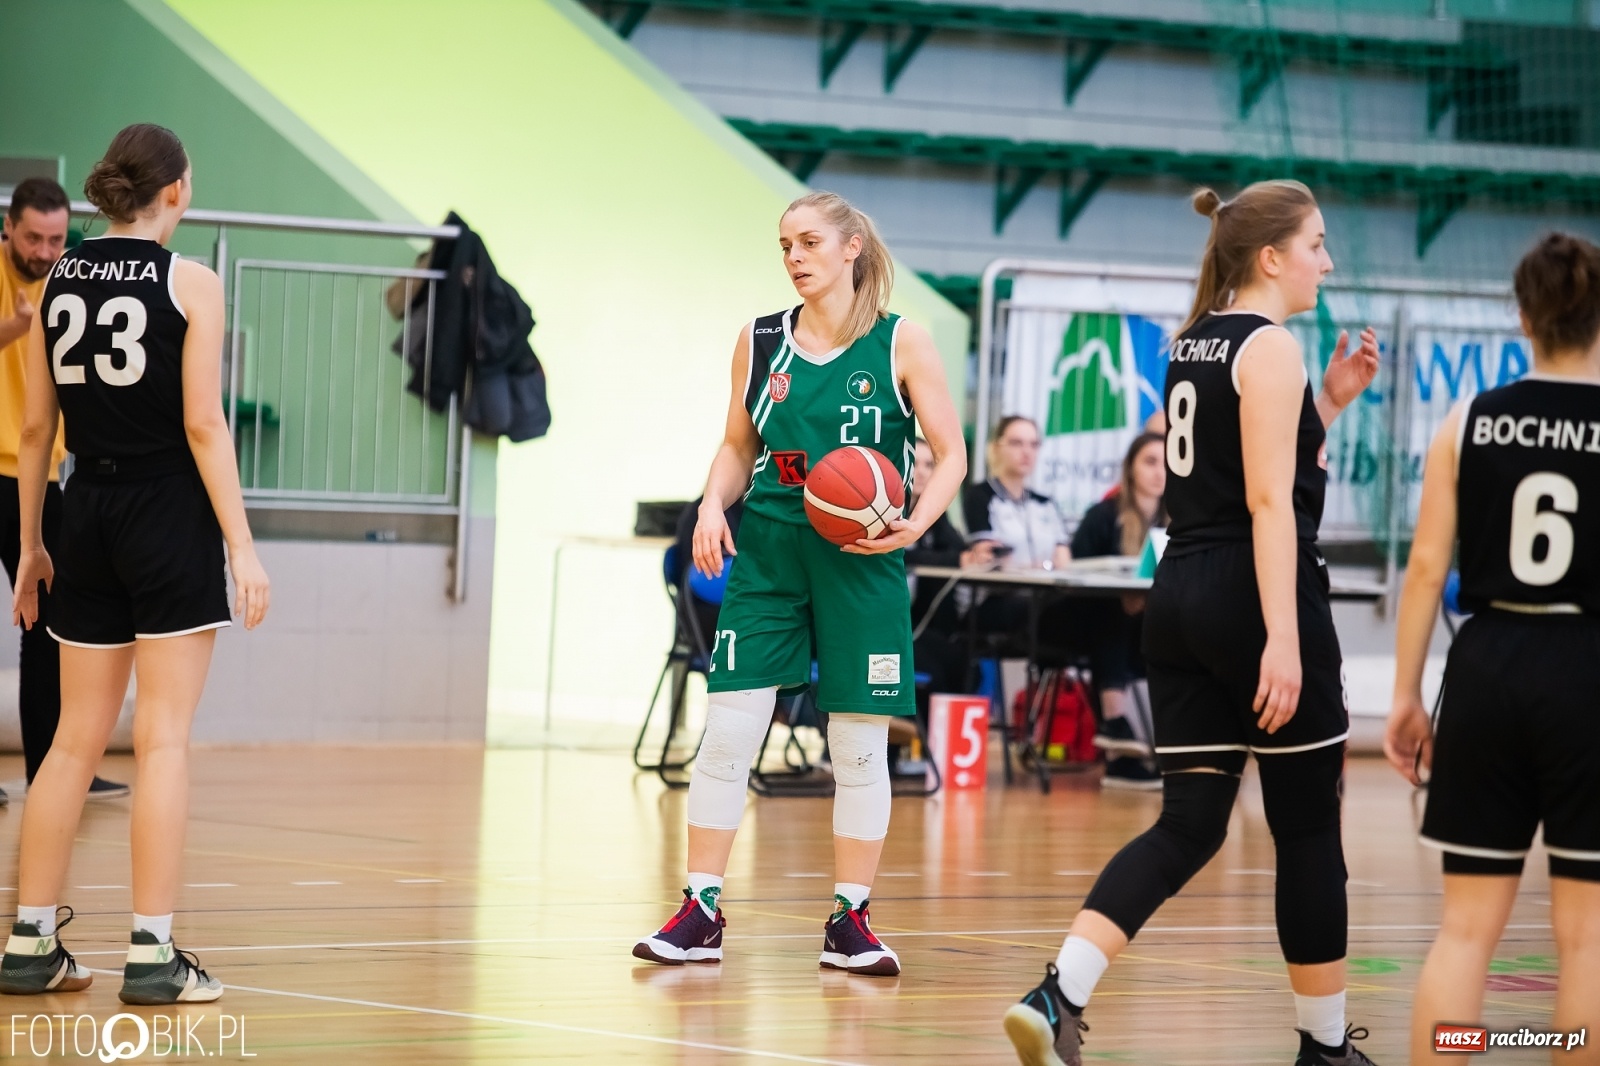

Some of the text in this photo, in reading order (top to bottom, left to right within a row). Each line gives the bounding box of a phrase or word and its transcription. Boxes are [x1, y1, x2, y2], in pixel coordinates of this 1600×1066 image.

[54, 257, 159, 283] BOCHNIA
[47, 293, 148, 387] 23
[755, 326, 783, 334] COLO
[1168, 337, 1231, 364] OCHNIA
[840, 405, 882, 444] 27
[1166, 380, 1197, 478] 8
[1472, 414, 1600, 454] BOCHNI
[1509, 470, 1579, 586] 6
